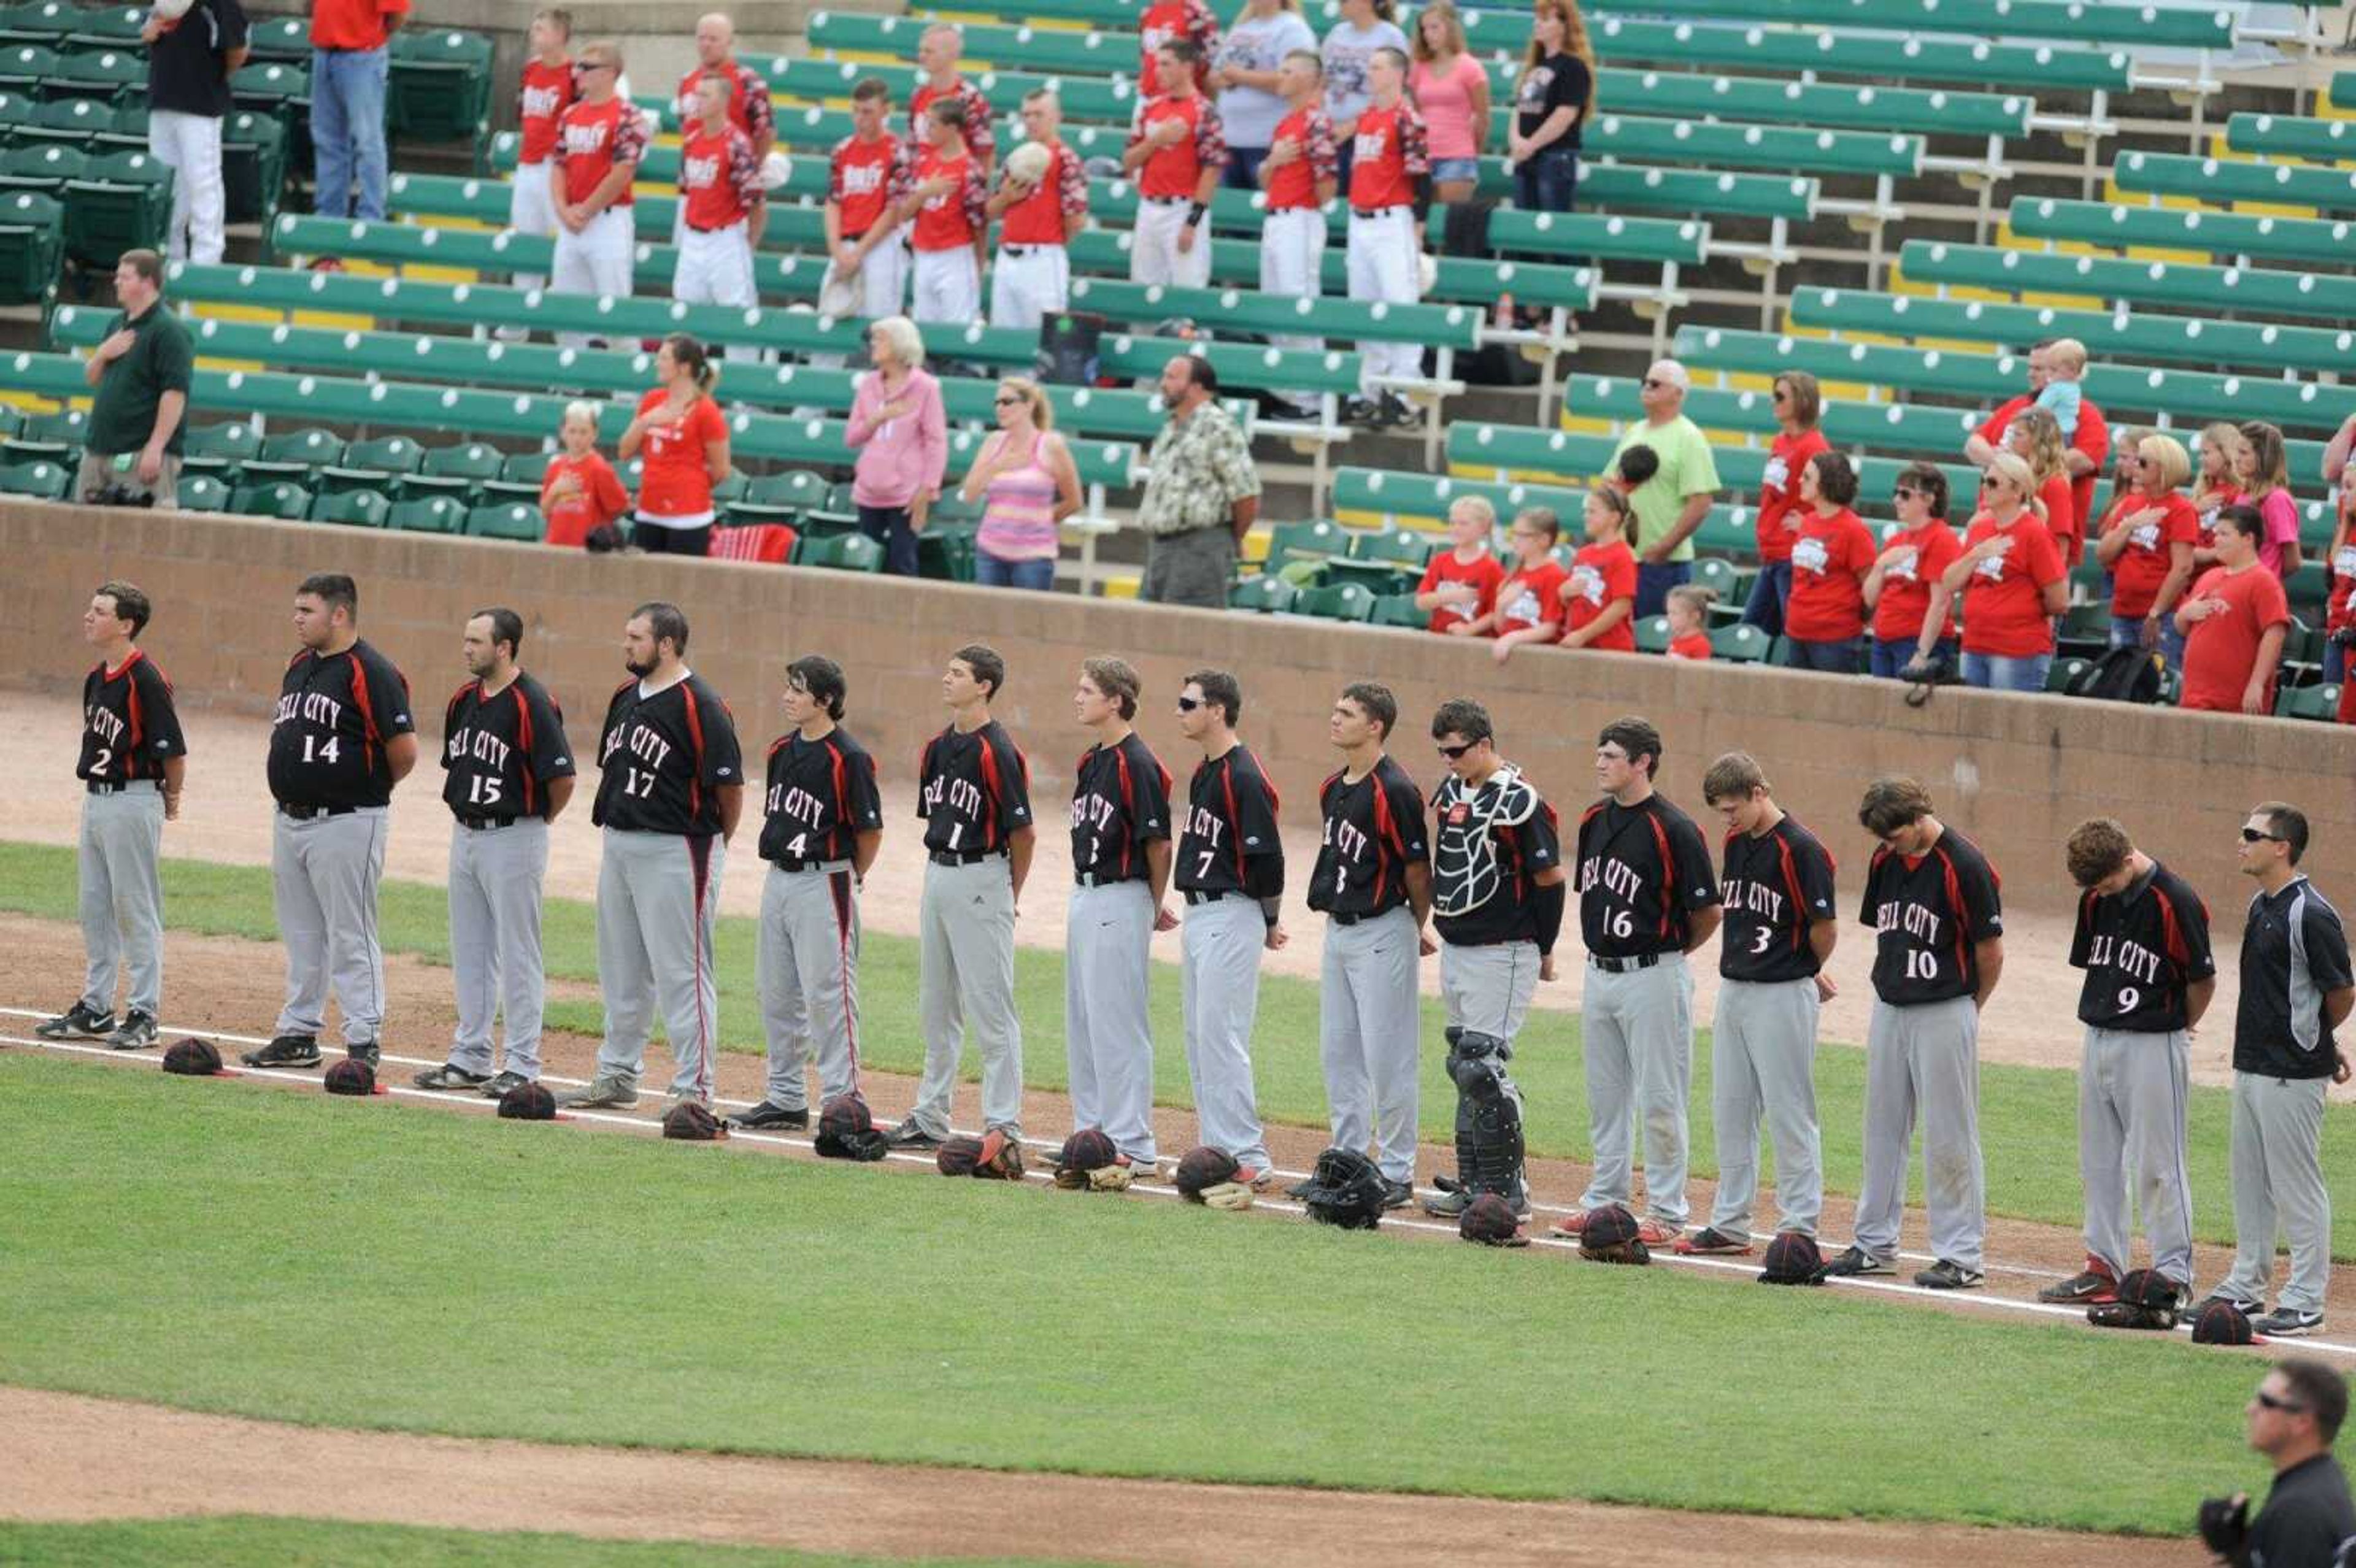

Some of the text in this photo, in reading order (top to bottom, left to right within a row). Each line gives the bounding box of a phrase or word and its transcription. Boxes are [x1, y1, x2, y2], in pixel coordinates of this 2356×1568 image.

[304, 692, 341, 729] CITY
[90, 748, 112, 775] 2
[302, 736, 340, 763] 14
[473, 729, 510, 772] CITY
[630, 724, 671, 769] CITY
[469, 775, 502, 805] 15
[624, 767, 655, 797] 17
[785, 786, 823, 831] CITY
[786, 832, 807, 859] 4
[948, 822, 963, 850] 1
[1196, 851, 1214, 879] 7
[1604, 858, 1642, 905] CITY
[1748, 881, 1782, 922] CITY
[1603, 905, 1633, 938] 16
[1904, 902, 1941, 945] CITY
[1749, 926, 1772, 953] 3
[1906, 949, 1938, 979] 10
[2119, 940, 2161, 985] CITY
[2118, 986, 2139, 1013] 9
